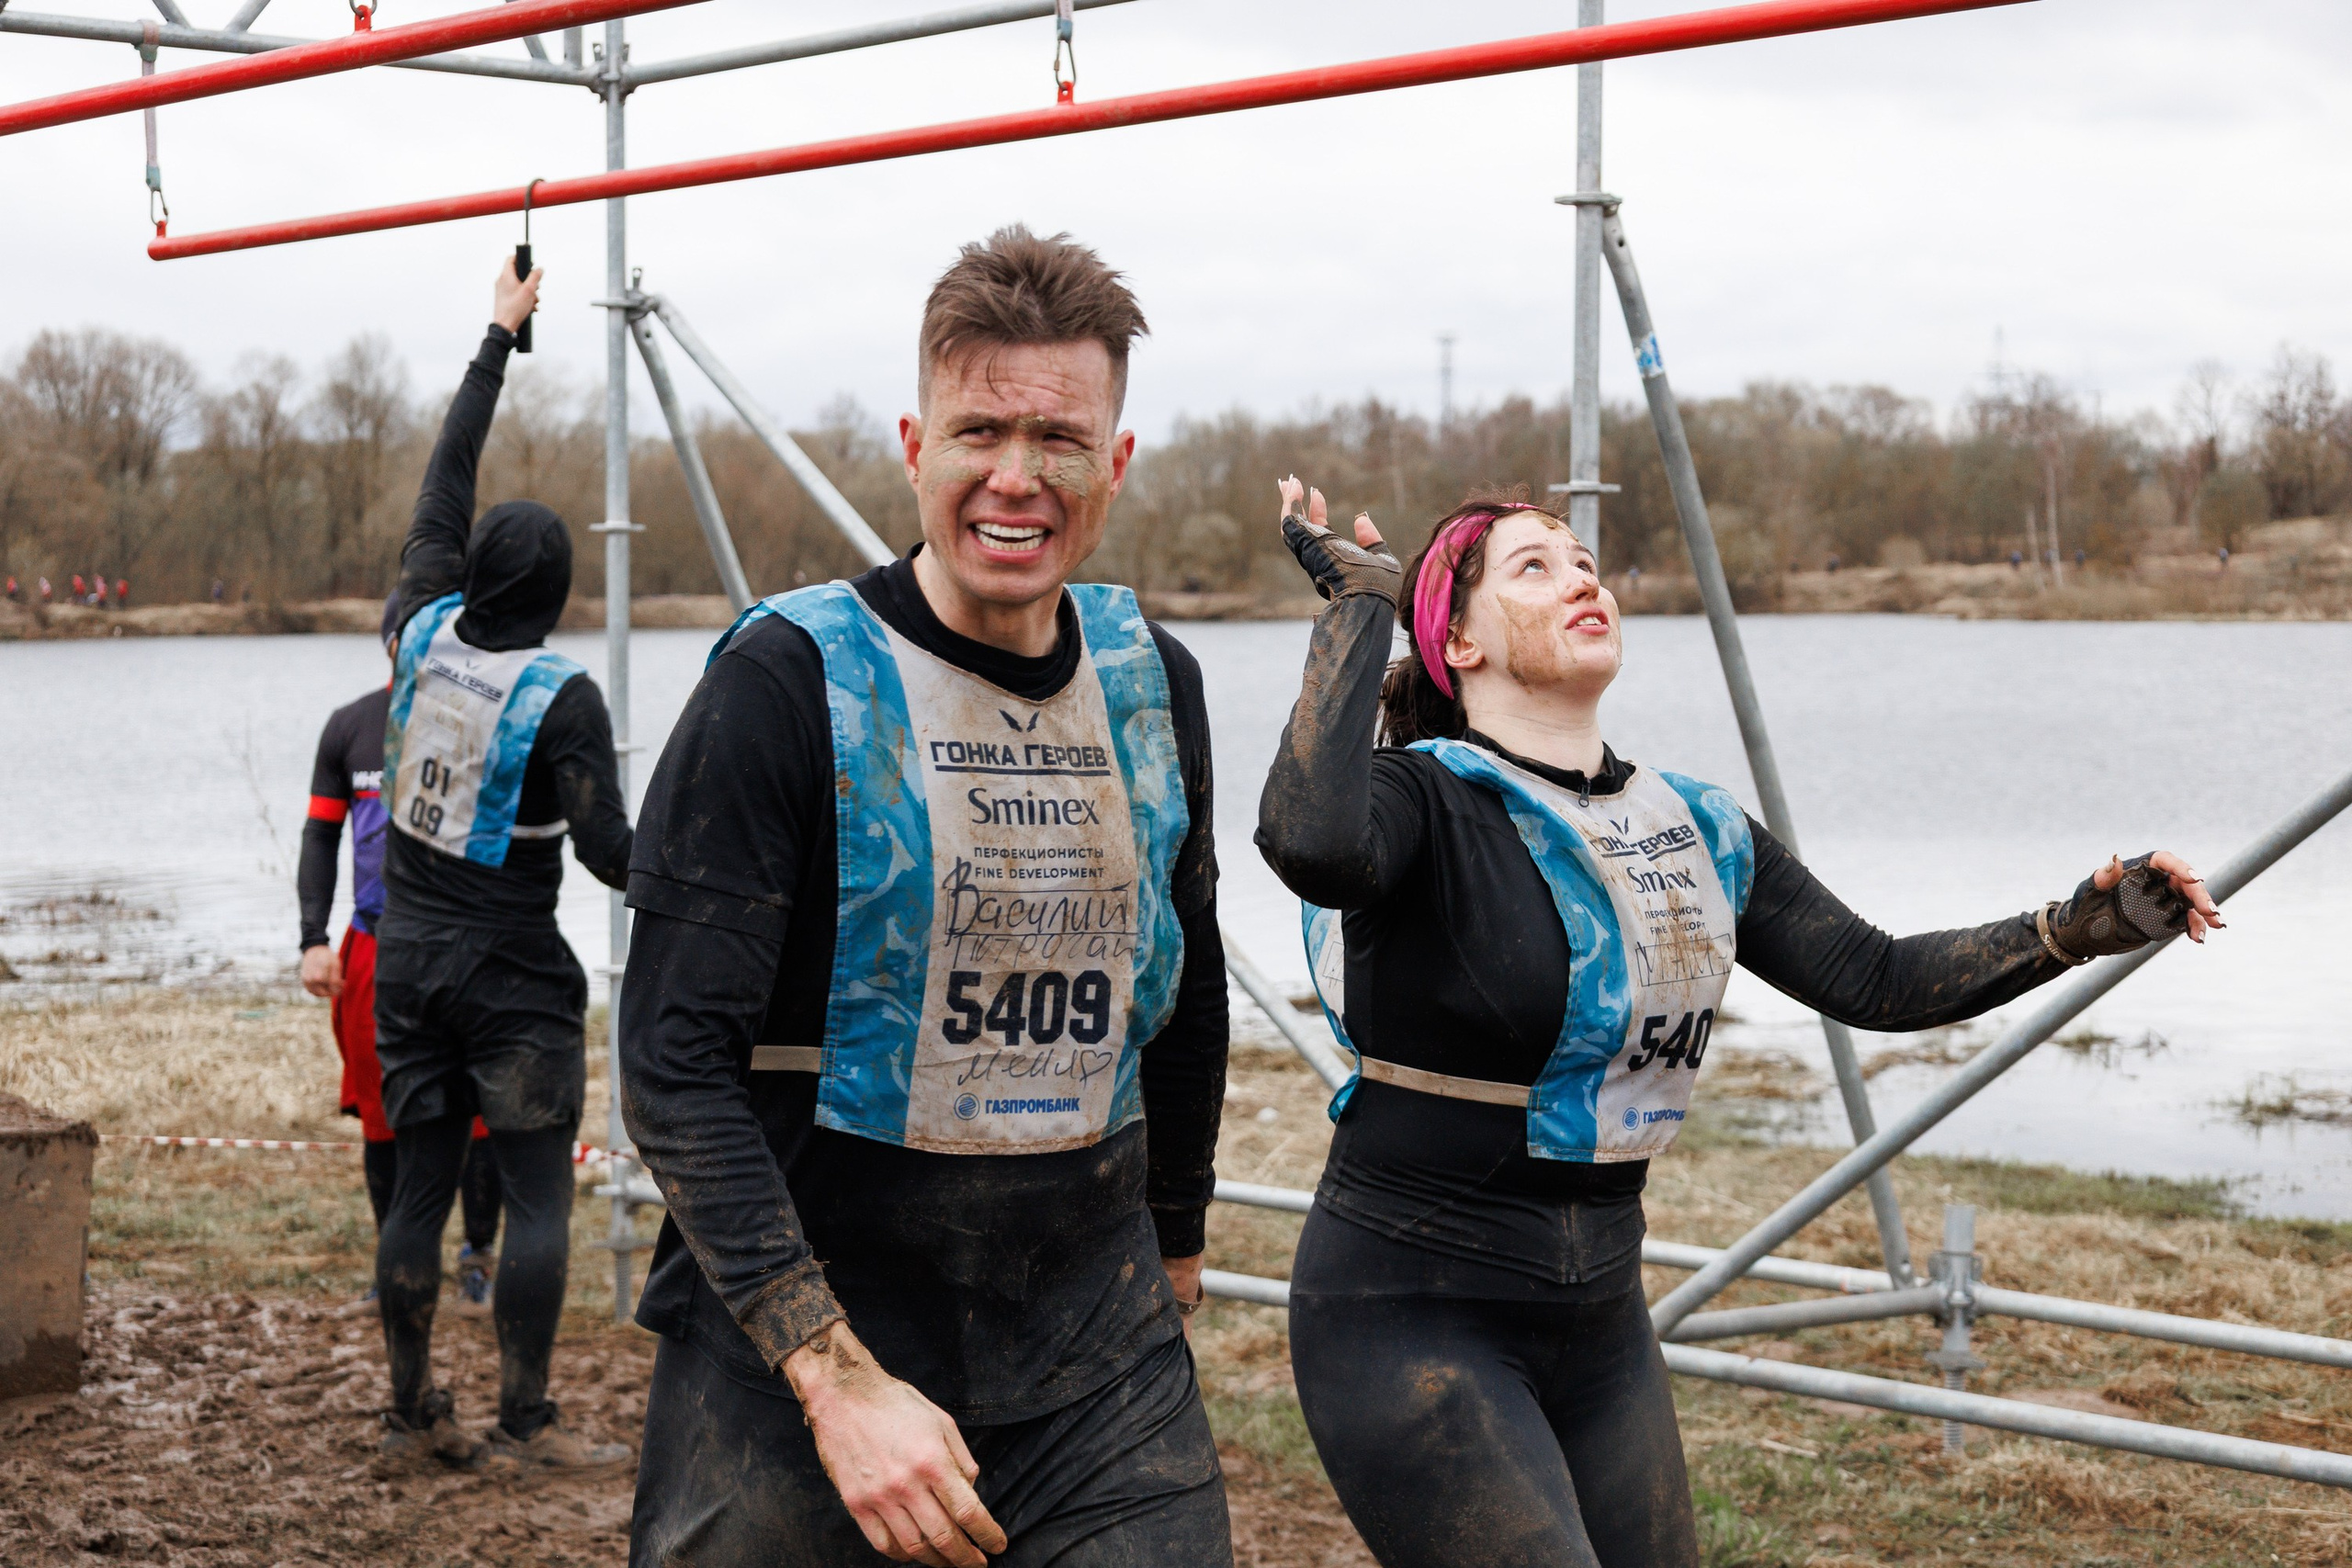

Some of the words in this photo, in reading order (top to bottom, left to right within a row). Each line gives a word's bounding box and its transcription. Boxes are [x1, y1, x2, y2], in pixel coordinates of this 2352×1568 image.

[930, 740, 1017, 766] ГОНКА
[1023, 743, 1108, 768] ГЕРОЕВ
[422, 757, 451, 797] 01
[410, 796, 445, 836] 09
[967, 787, 1101, 826] Sminex
[974, 847, 1104, 861] ПЕРФЕКЦИОНИСТЫ
[975, 867, 1003, 879] FINE
[1010, 867, 1104, 879] DEVELOPMENT
[942, 970, 1112, 1045] 5409
[1627, 1008, 1717, 1072] 540
[985, 1098, 1080, 1114] ГАЗПРОМБАНК
